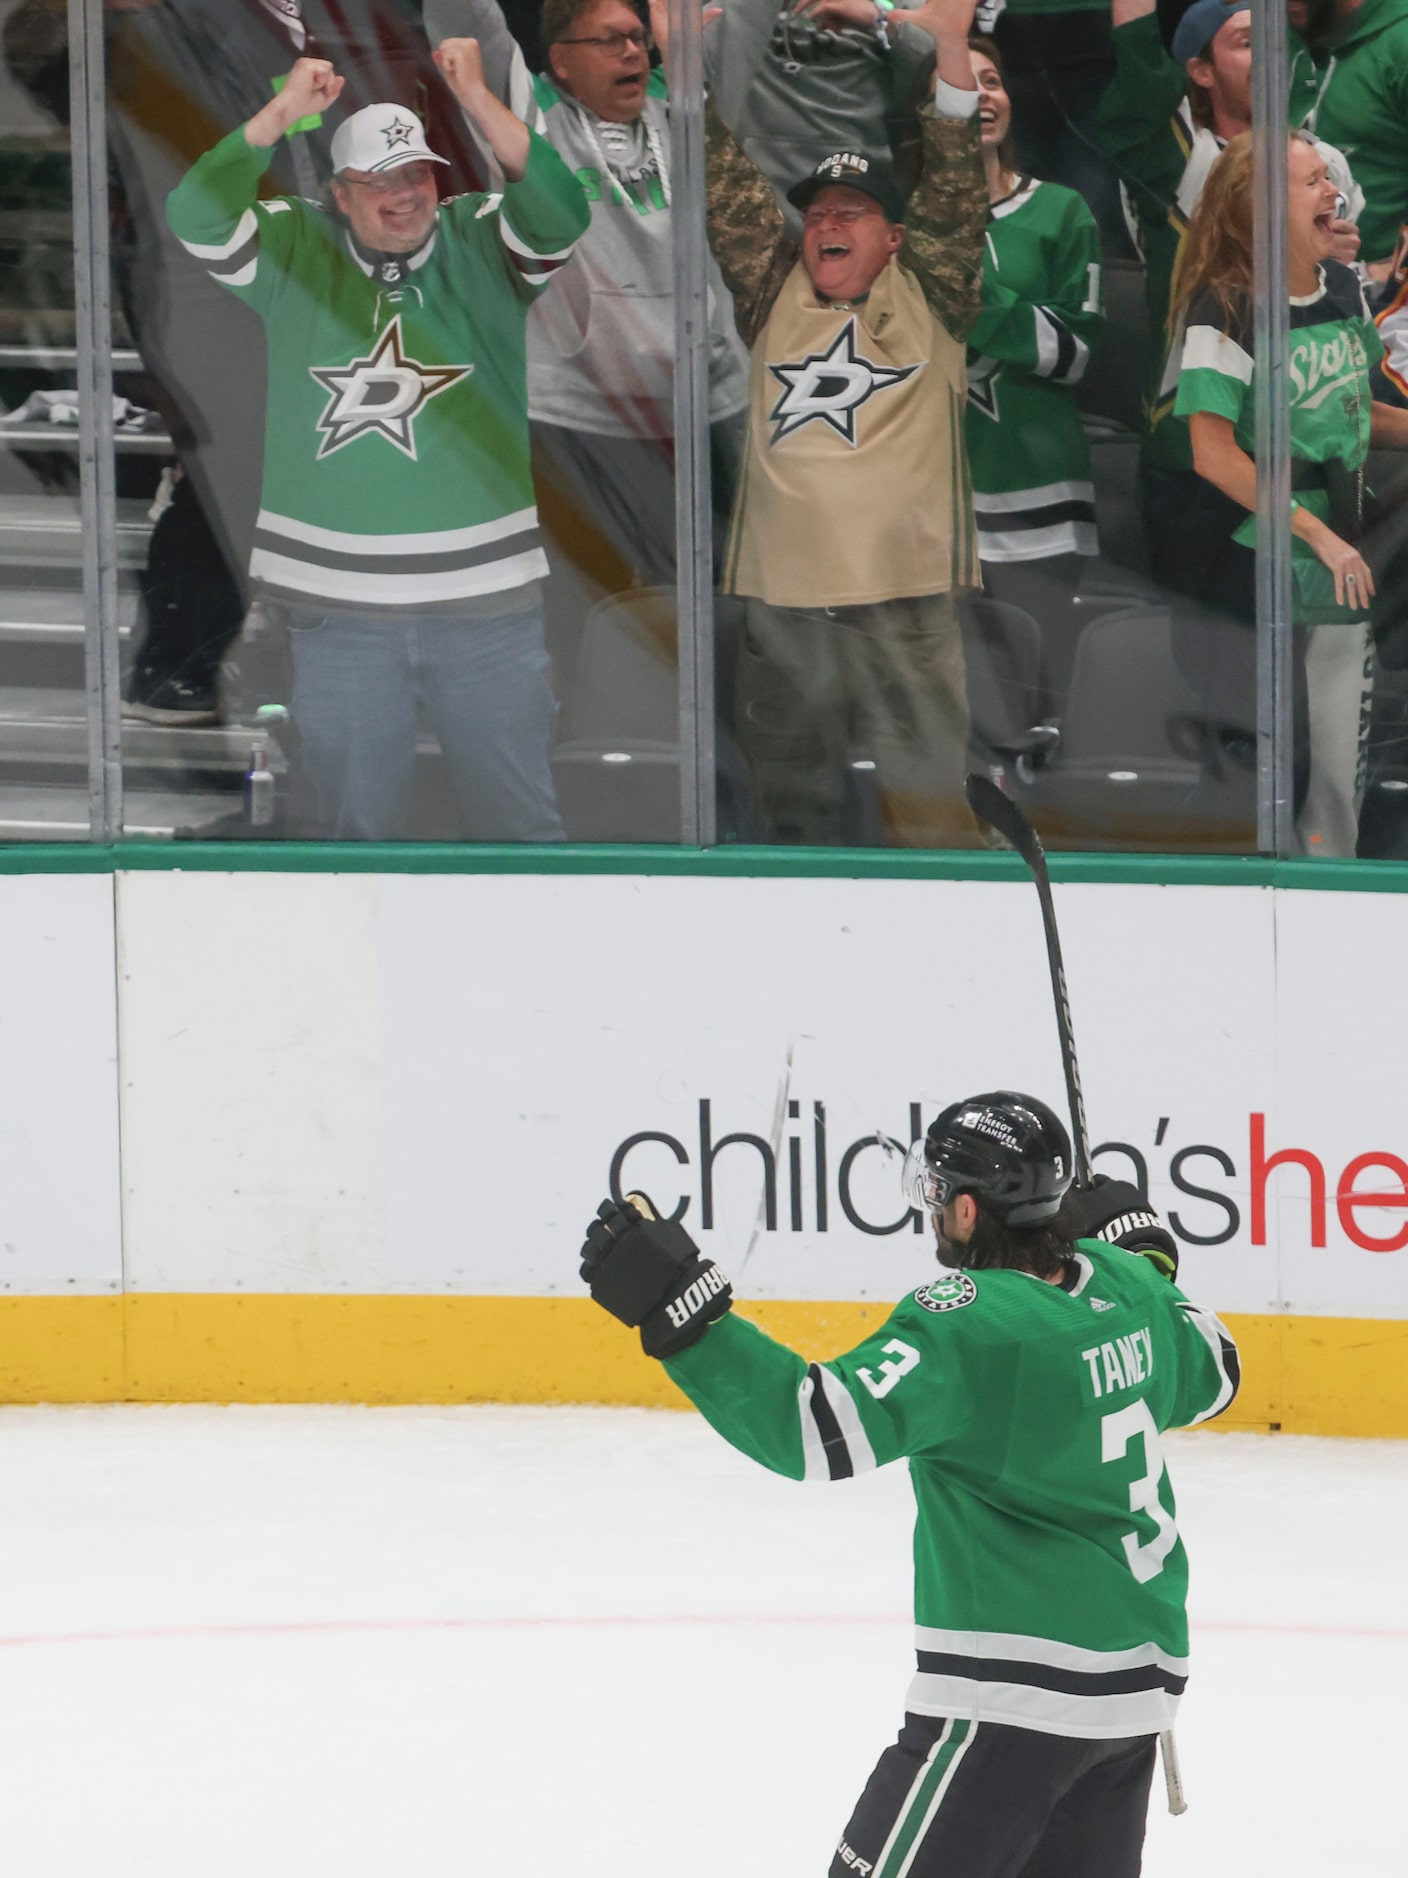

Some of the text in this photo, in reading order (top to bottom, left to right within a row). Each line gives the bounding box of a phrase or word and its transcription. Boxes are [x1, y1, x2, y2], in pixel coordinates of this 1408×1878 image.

[1053, 1155, 1064, 1180] 3
[856, 1338, 921, 1400] 3
[1101, 1396, 1179, 1586] 3
[837, 1836, 873, 1877] UER
